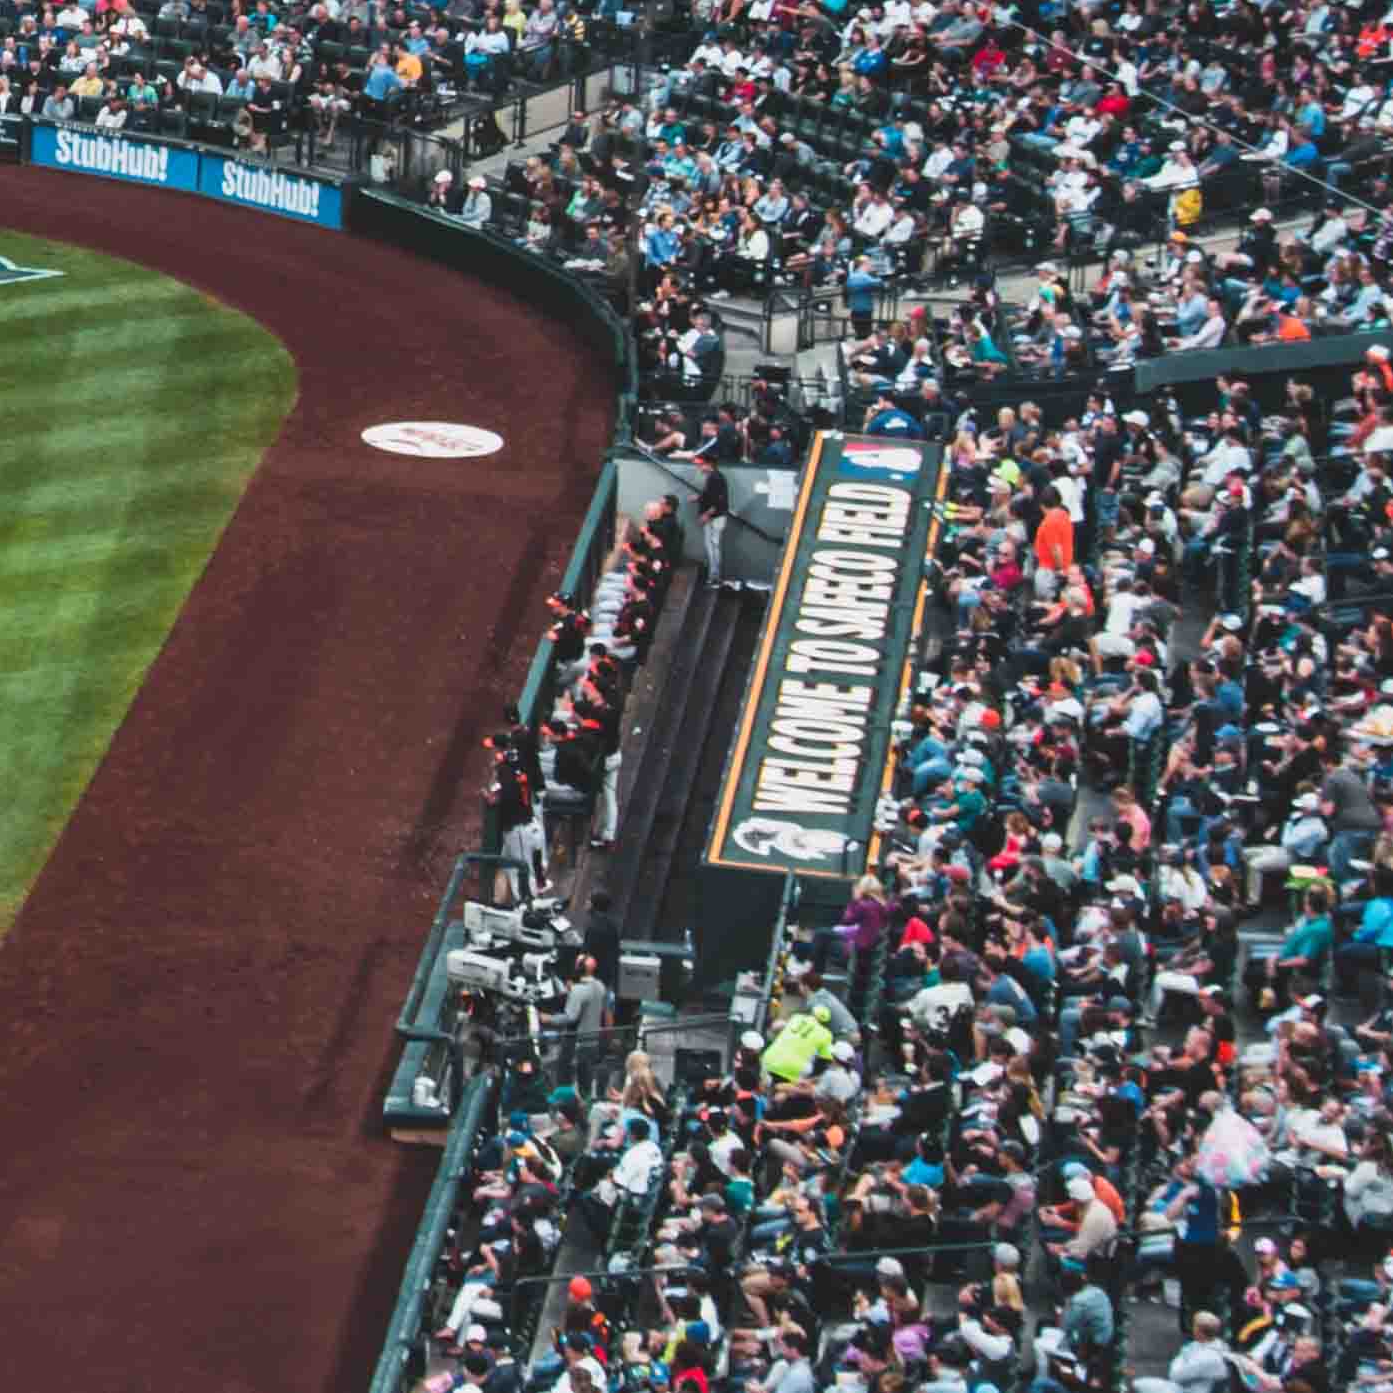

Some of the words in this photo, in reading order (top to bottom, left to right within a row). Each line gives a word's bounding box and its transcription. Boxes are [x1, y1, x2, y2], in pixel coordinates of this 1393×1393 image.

[54, 129, 168, 182] StubHub!
[221, 160, 320, 217] StubHub!
[817, 481, 912, 549] FIELD
[795, 550, 898, 641] SAFECO
[785, 639, 881, 676] TO
[752, 679, 873, 814] WELCOME
